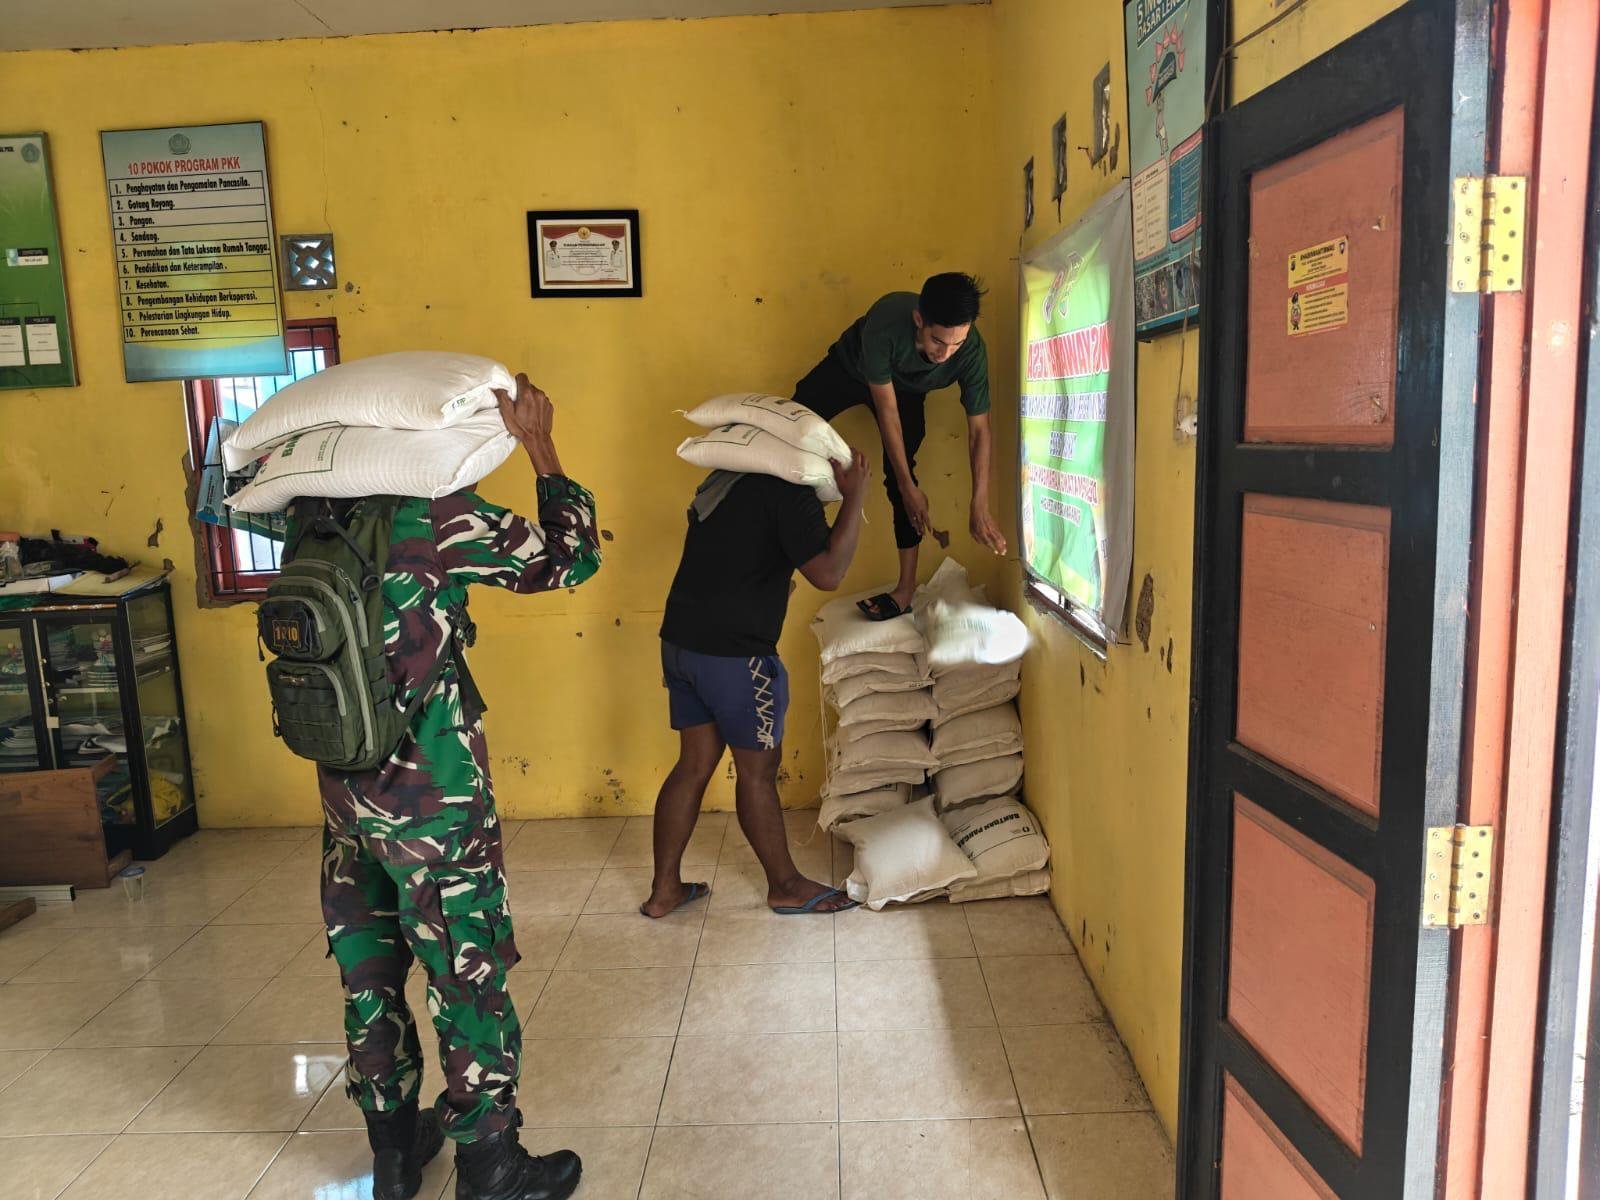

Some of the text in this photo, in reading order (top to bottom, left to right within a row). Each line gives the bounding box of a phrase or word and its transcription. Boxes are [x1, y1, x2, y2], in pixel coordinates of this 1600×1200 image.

[1138, 3, 1143, 25] 5
[1137, 7, 1161, 42] DASAR
[128, 156, 241, 175] 10 POKOK PROGRAM PKK
[115, 176, 251, 196] 1. Penghayatan dan Pengamalan Pancasila.
[117, 198, 175, 211] 2. Gotong Royong.
[119, 215, 155, 228] 3. Pangan.
[120, 230, 160, 243] 4. Sandang.
[122, 241, 271, 259] 5. Perumahan dan Tata Laksana Rumah Tangga.
[123, 264, 130, 275] 6.
[135, 262, 169, 274] Pendidikan
[170, 261, 181, 272] dan
[125, 279, 170, 291] 7. Kesehatan.
[126, 290, 258, 307] 8. Pengembangan Kehidupan Berkoperasi.
[128, 307, 232, 322] 9. Pelestarian Lingkungan Hidup.
[126, 324, 200, 338] 10. Perencanaan Sehat.
[984, 813, 1020, 830] BANTUAN
